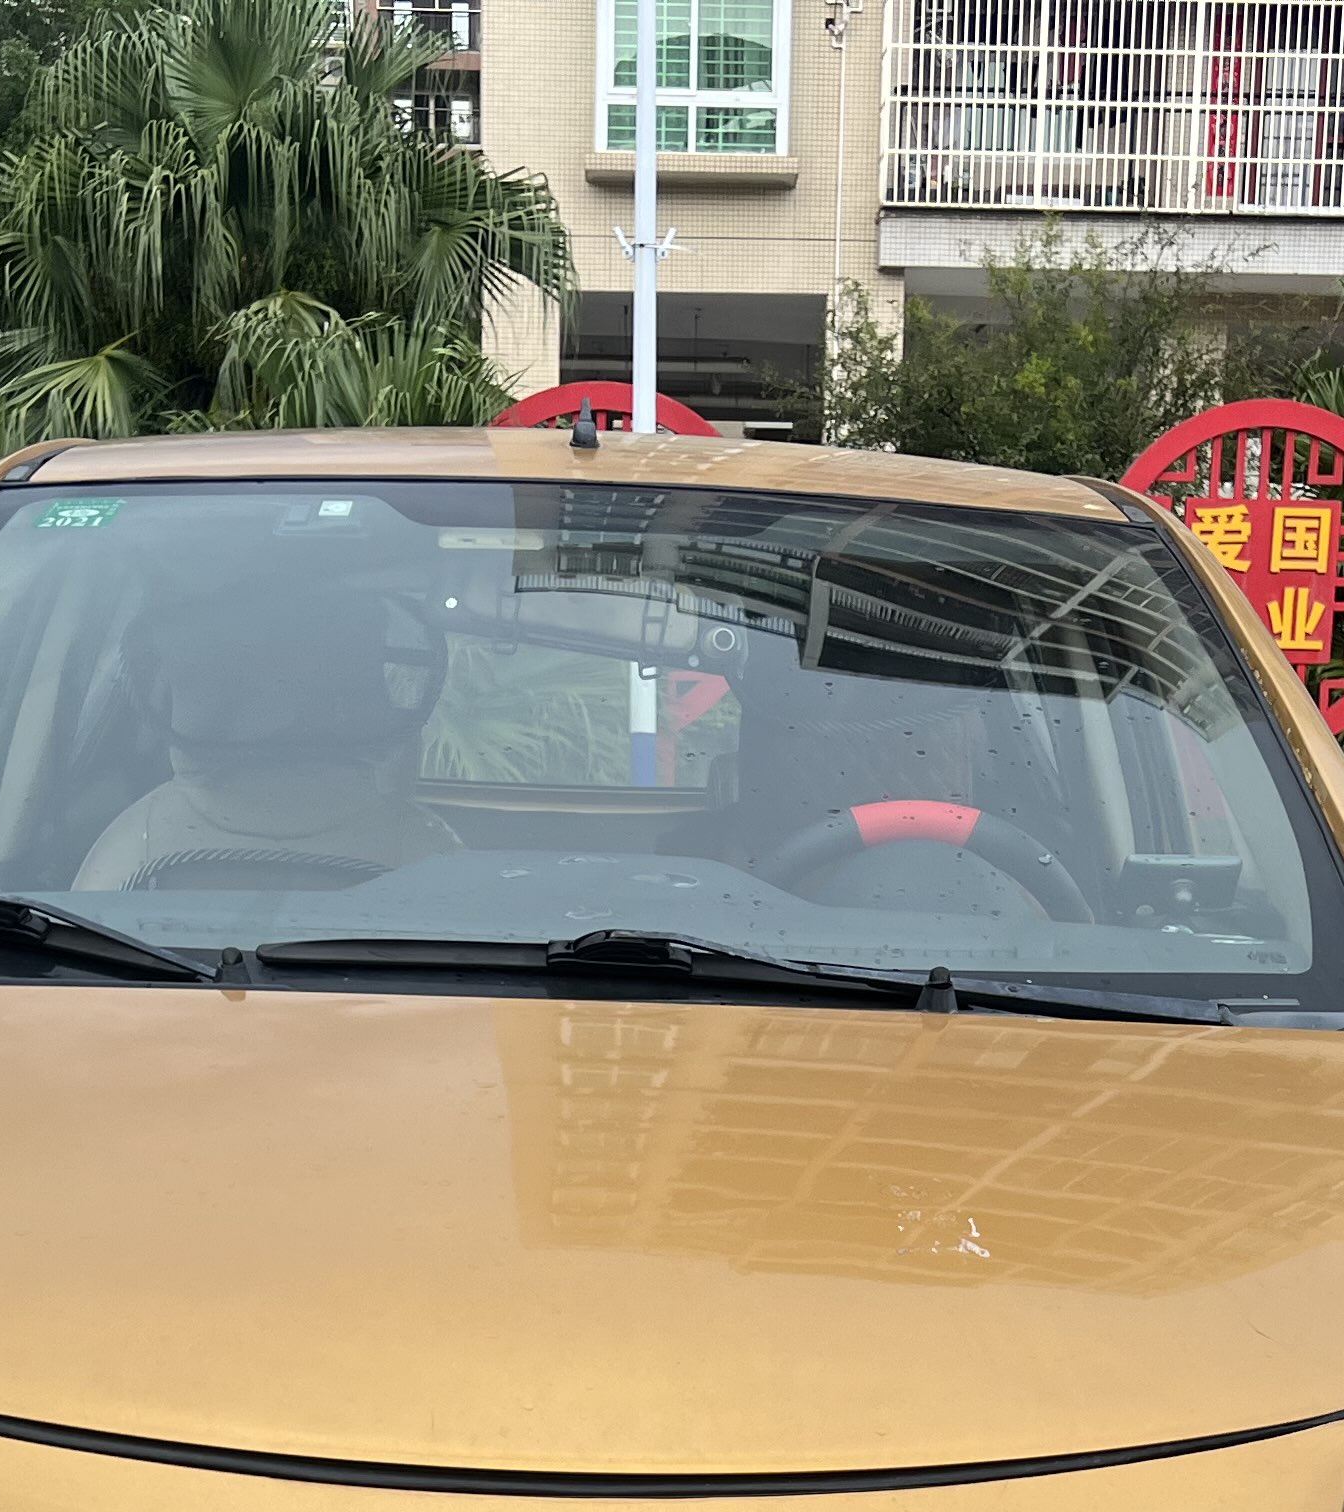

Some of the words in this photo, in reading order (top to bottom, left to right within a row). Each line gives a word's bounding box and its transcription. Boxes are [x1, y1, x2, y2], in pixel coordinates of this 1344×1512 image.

[37, 516, 104, 528] 2021
[1190, 503, 1332, 574] 爱国
[1266, 586, 1326, 651] 业
